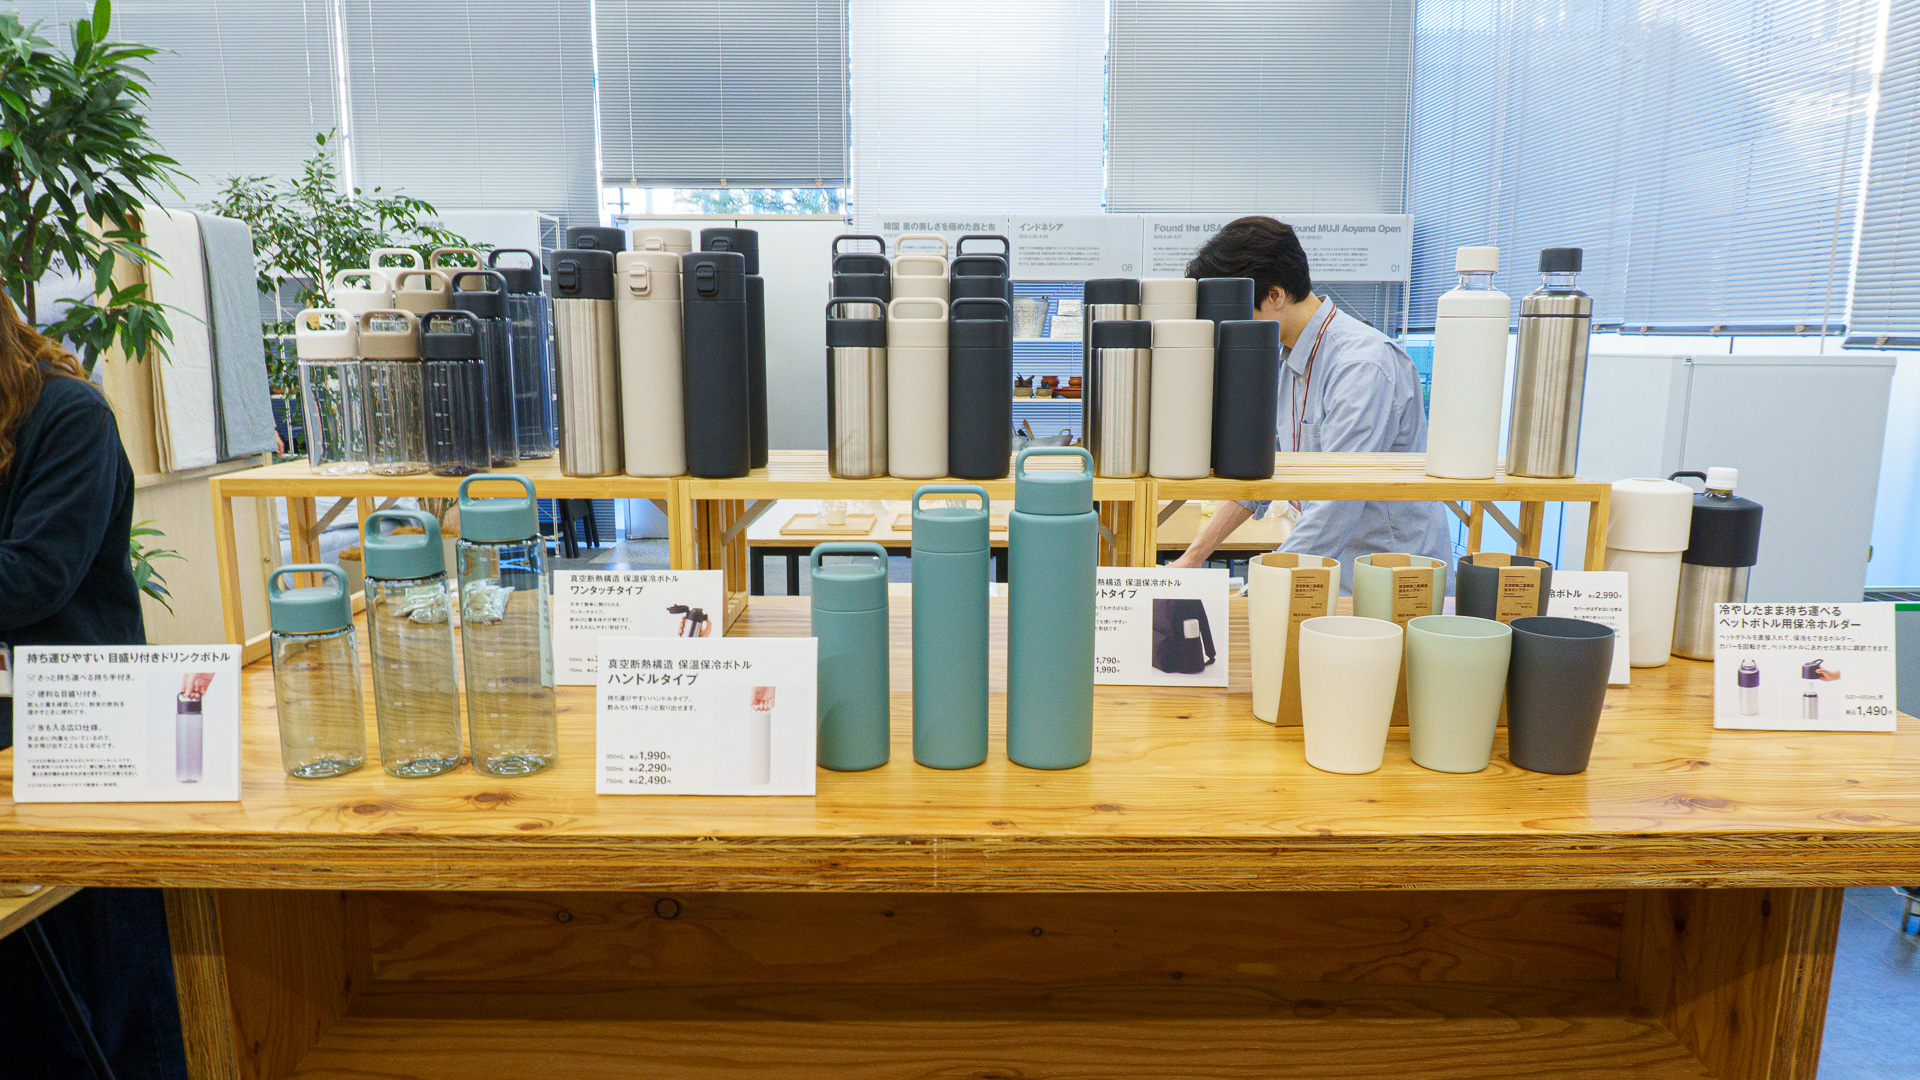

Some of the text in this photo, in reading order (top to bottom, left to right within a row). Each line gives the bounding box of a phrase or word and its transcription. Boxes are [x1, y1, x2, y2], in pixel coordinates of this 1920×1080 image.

[884, 222, 996, 232] 韓国 素の美しさを極めた器と布
[1019, 223, 1064, 232] インドネシア
[1154, 224, 1222, 232] Found the USA
[1318, 224, 1340, 233] MUJI
[1341, 225, 1377, 235] Aoyama
[1378, 225, 1401, 235] Open
[1122, 263, 1133, 272] 08
[1391, 264, 1401, 273] 01
[570, 574, 679, 583] 真空断熱構造 保温保冷ボトル
[1125, 579, 1181, 587] 保温保冷ボトル
[570, 585, 644, 595] ワンタッチタイプ
[1719, 604, 1842, 617] 冷やしたまま持ち運べる
[1719, 618, 1861, 630] ペットボトル用保冷ホルダー
[27, 652, 231, 664] 持ち運びやすい 目盛り付きドリンクボトル
[608, 659, 752, 670] 真空断熱構造 保温保冷ボトル
[608, 673, 699, 685] ハンドルタイプ
[37, 690, 102, 698] 便利な目盛り付き。
[607, 704, 697, 712] 飲みたい時にさっと取り出せます。
[37, 724, 102, 732] 氷も入る広口仕様。
